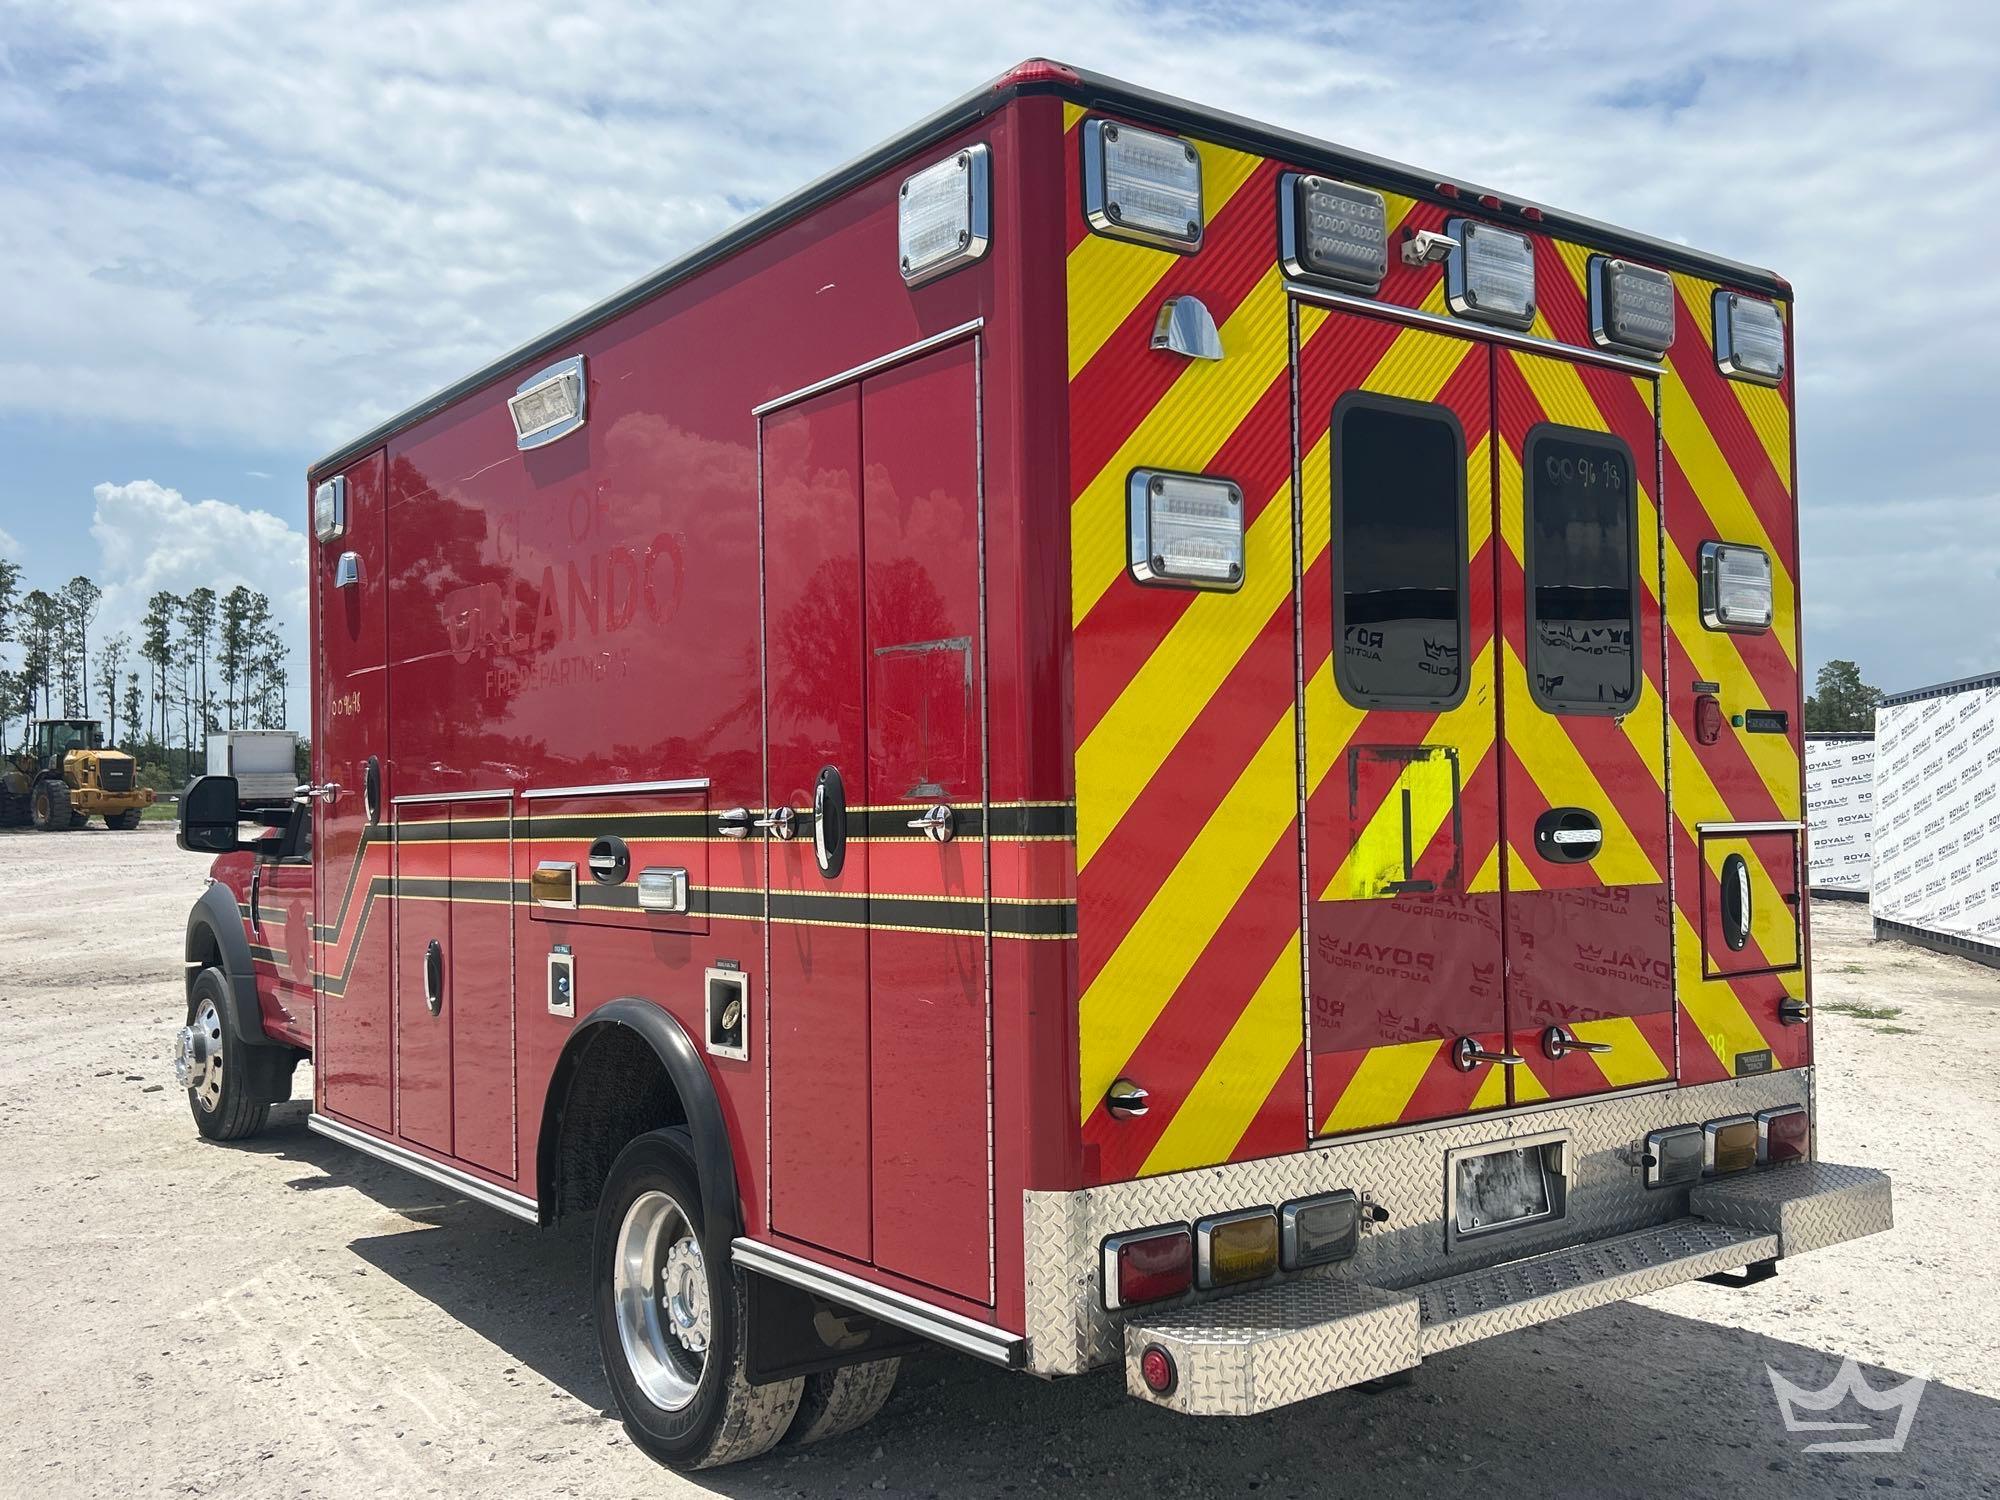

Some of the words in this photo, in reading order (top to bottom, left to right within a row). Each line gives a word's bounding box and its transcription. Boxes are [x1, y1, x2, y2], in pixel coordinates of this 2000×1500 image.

[1832, 775, 1863, 785] ROYAL
[1808, 799, 1839, 808] ROYAL
[1838, 814, 1870, 823] ROYAL
[1814, 837, 1846, 845] ROYAL
[1820, 875, 1852, 883] ROYAL
